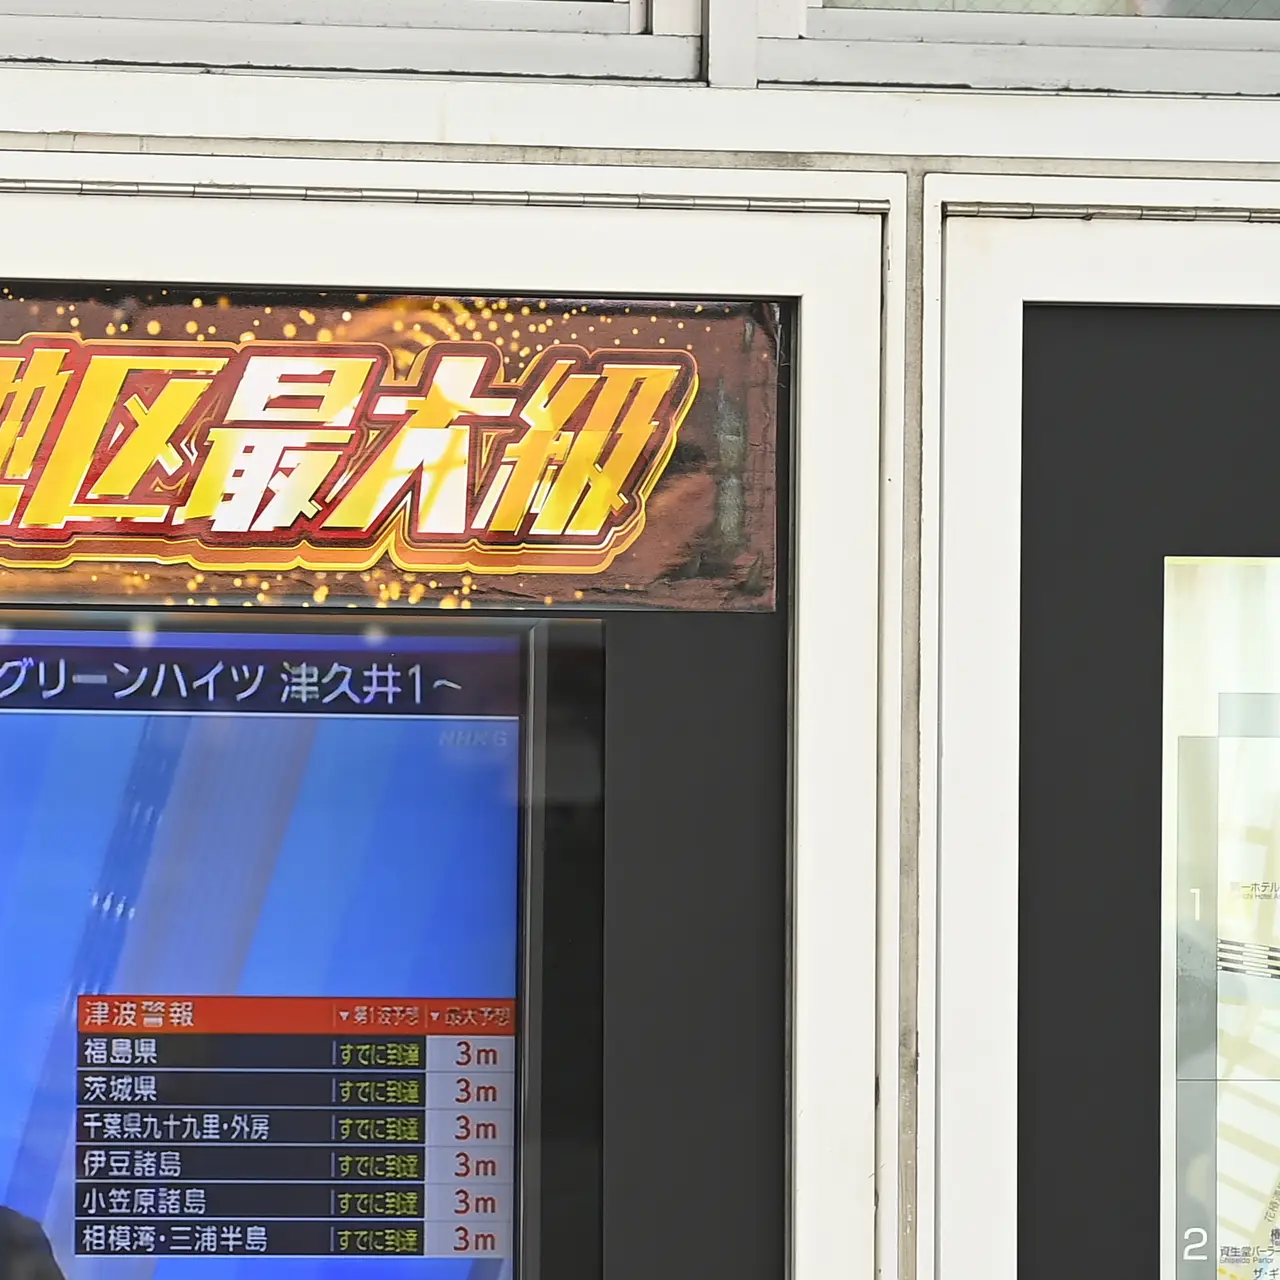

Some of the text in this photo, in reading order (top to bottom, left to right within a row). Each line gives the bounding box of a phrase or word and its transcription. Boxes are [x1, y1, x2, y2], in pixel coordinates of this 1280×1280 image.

[1189, 888, 1201, 921] 1
[84, 1001, 194, 1027] 津波警報
[84, 1038, 157, 1064] 福島県
[339, 1043, 420, 1066] すでに到達
[83, 1075, 157, 1101] 茨城県
[339, 1080, 420, 1103] すでに到達
[338, 1117, 419, 1140] すでに到達
[83, 1150, 182, 1177] 伊豆諸島
[338, 1154, 419, 1178] すでに到達
[82, 1187, 206, 1214] 小笠原諸島
[337, 1191, 418, 1215] すでに到達
[81, 1224, 268, 1252] 相模湾・三浦半島
[337, 1228, 418, 1252] すでに到達
[1182, 1227, 1208, 1261] 2
